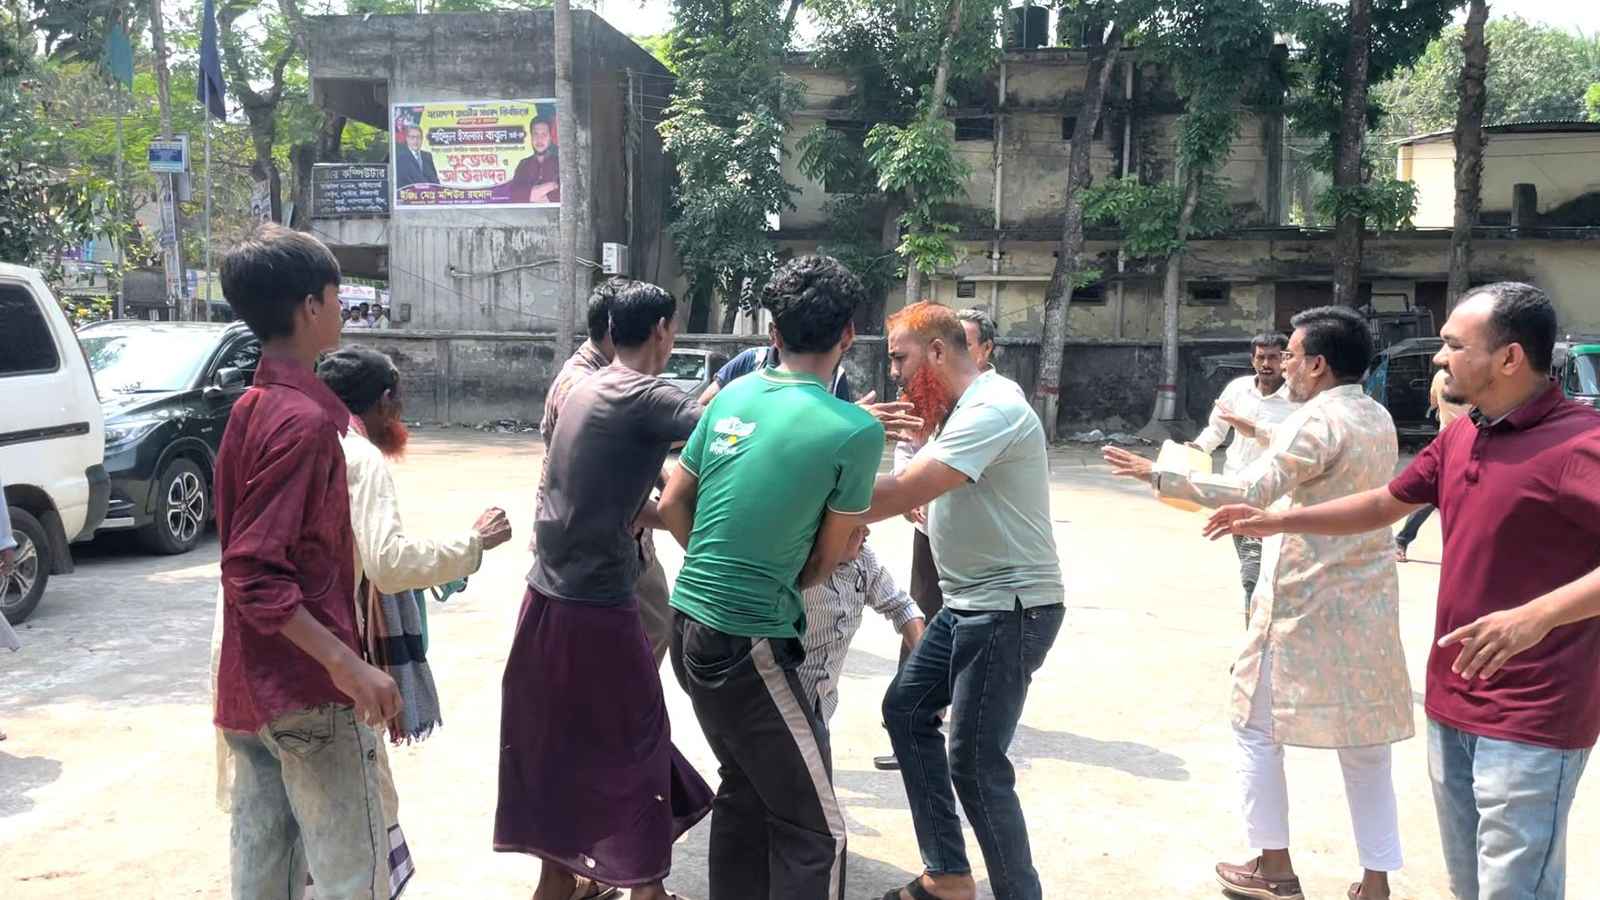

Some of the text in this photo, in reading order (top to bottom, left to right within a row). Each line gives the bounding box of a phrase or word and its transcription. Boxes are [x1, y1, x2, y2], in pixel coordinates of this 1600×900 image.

[457, 128, 483, 142] ইসলাম
[485, 129, 508, 142] বাবুল
[447, 154, 498, 169] শুভেচ্ছা
[342, 166, 385, 179] কম্পিউটার
[439, 169, 505, 181] অভিনন্দন
[467, 190, 493, 200] রহমান
